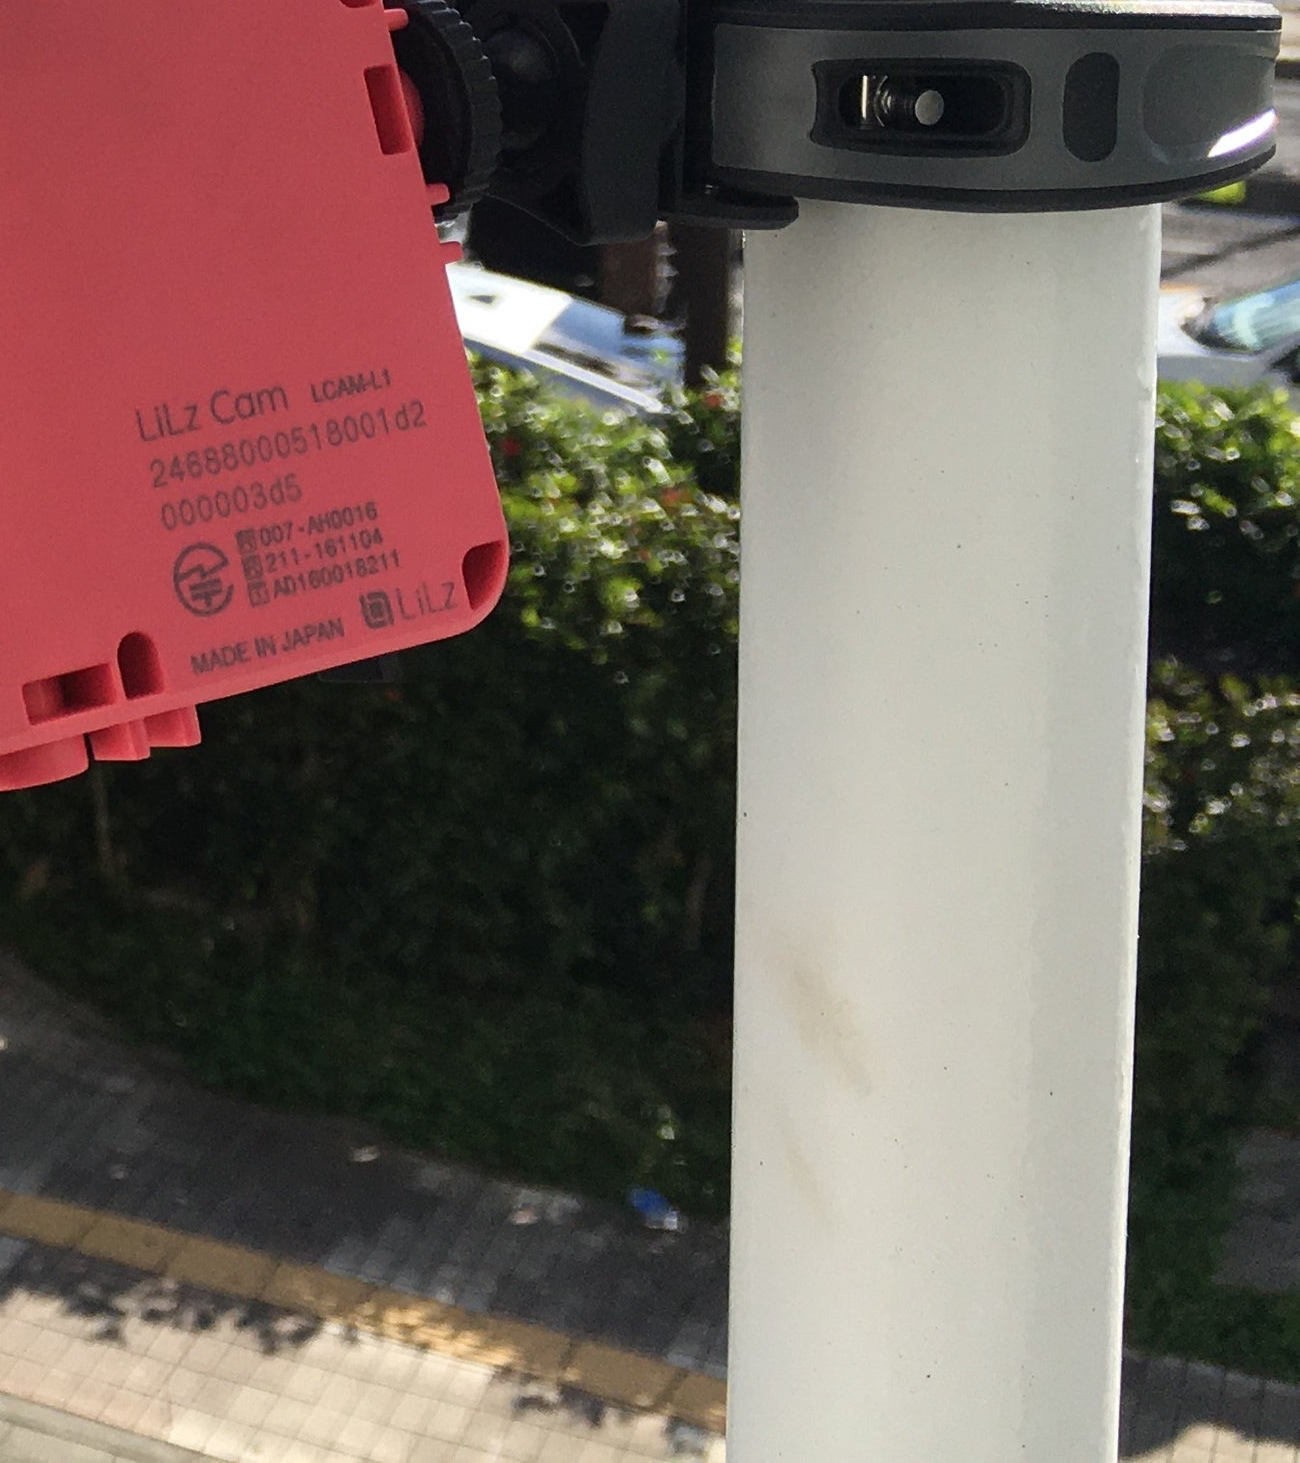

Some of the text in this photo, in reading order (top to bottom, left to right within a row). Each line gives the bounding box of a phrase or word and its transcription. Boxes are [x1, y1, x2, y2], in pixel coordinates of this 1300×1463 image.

[210, 386, 290, 425] Cam
[310, 368, 392, 403] LCAM-L1
[149, 400, 427, 488] 24688000518001d2
[161, 473, 303, 531] 000003d5
[190, 618, 346, 675] MADE IN JAPAN
